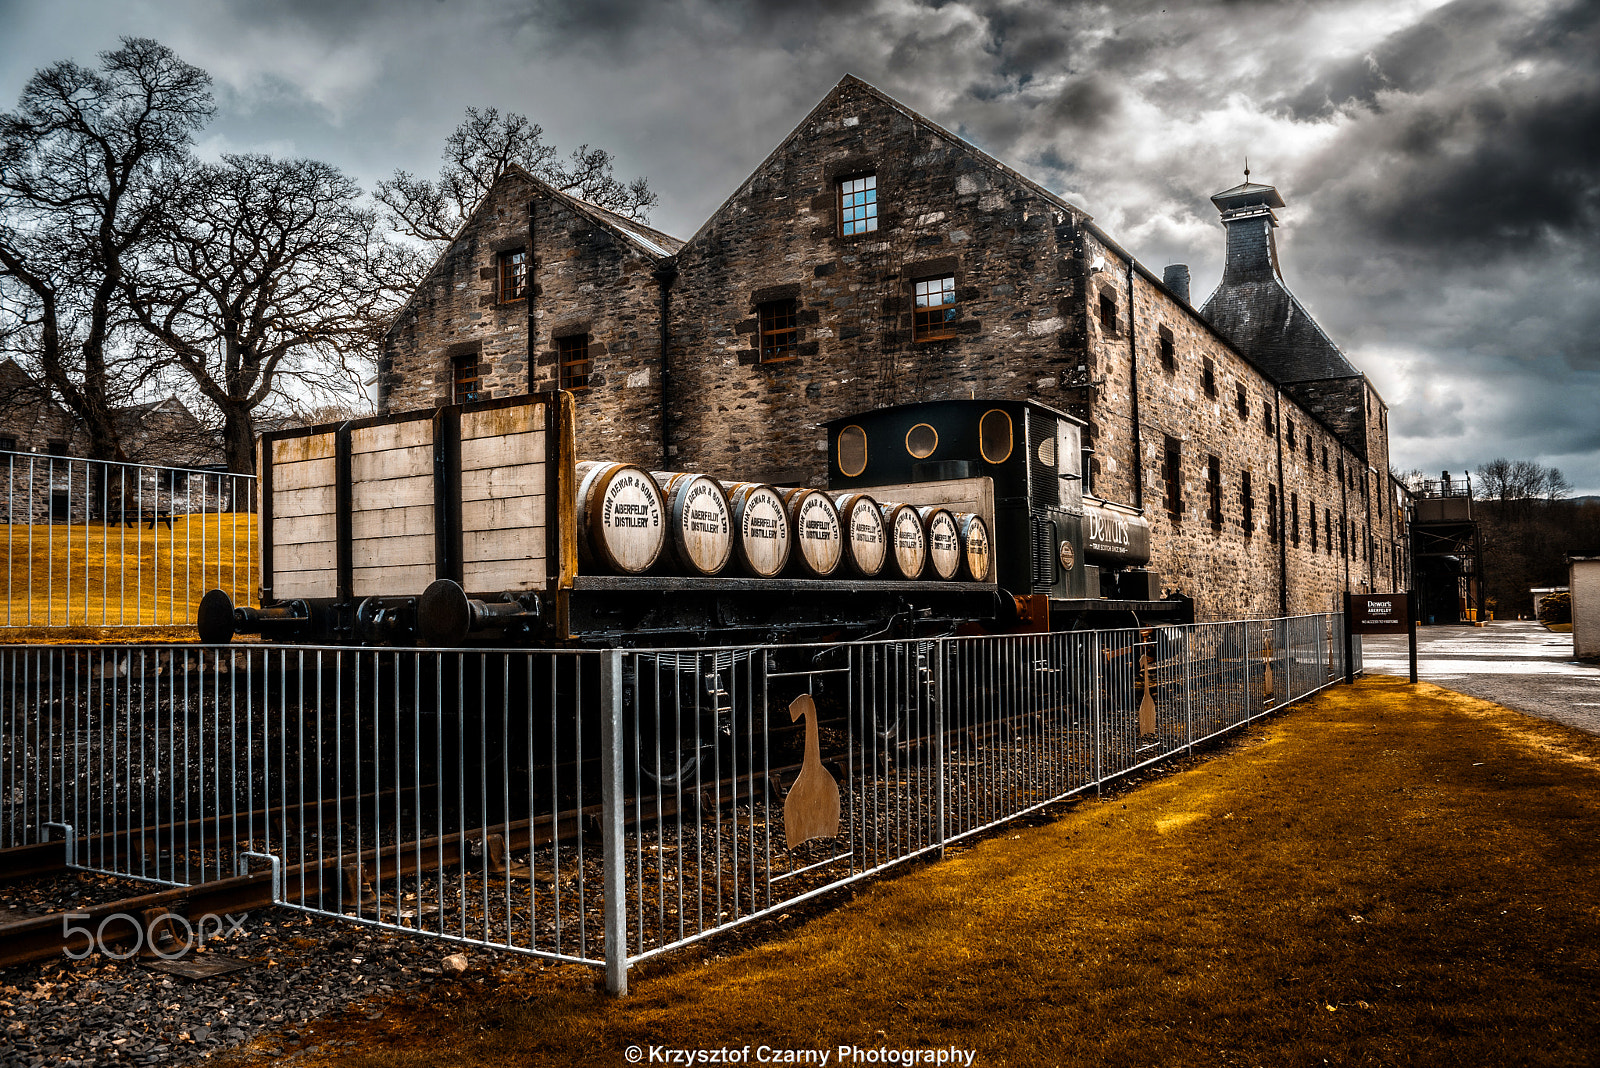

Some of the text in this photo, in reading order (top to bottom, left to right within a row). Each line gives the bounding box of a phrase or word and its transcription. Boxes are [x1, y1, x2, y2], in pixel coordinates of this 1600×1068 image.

[688, 486, 706, 501] DEWAR
[708, 488, 712, 497] &
[604, 497, 614, 527] JOHN
[611, 476, 632, 498] DEWAR
[634, 478, 640, 488] &
[641, 483, 656, 507] SONS
[748, 494, 766, 512] DEWAR
[767, 496, 771, 505] &
[803, 499, 817, 515] DEWAR
[615, 504, 648, 515] ABERFELDY
[691, 510, 719, 522] ABERFELDY
[615, 517, 648, 528] DISTILLERY
[691, 521, 719, 534] DISTILLERY
[751, 517, 777, 528] ABERFELDY
[806, 520, 830, 530] ABERFELDY
[856, 523, 876, 533] ABERFELDY
[751, 528, 777, 539] DISTILLERY
[806, 531, 830, 540] DISTILLERY
[856, 533, 876, 543] DISTILLERY
